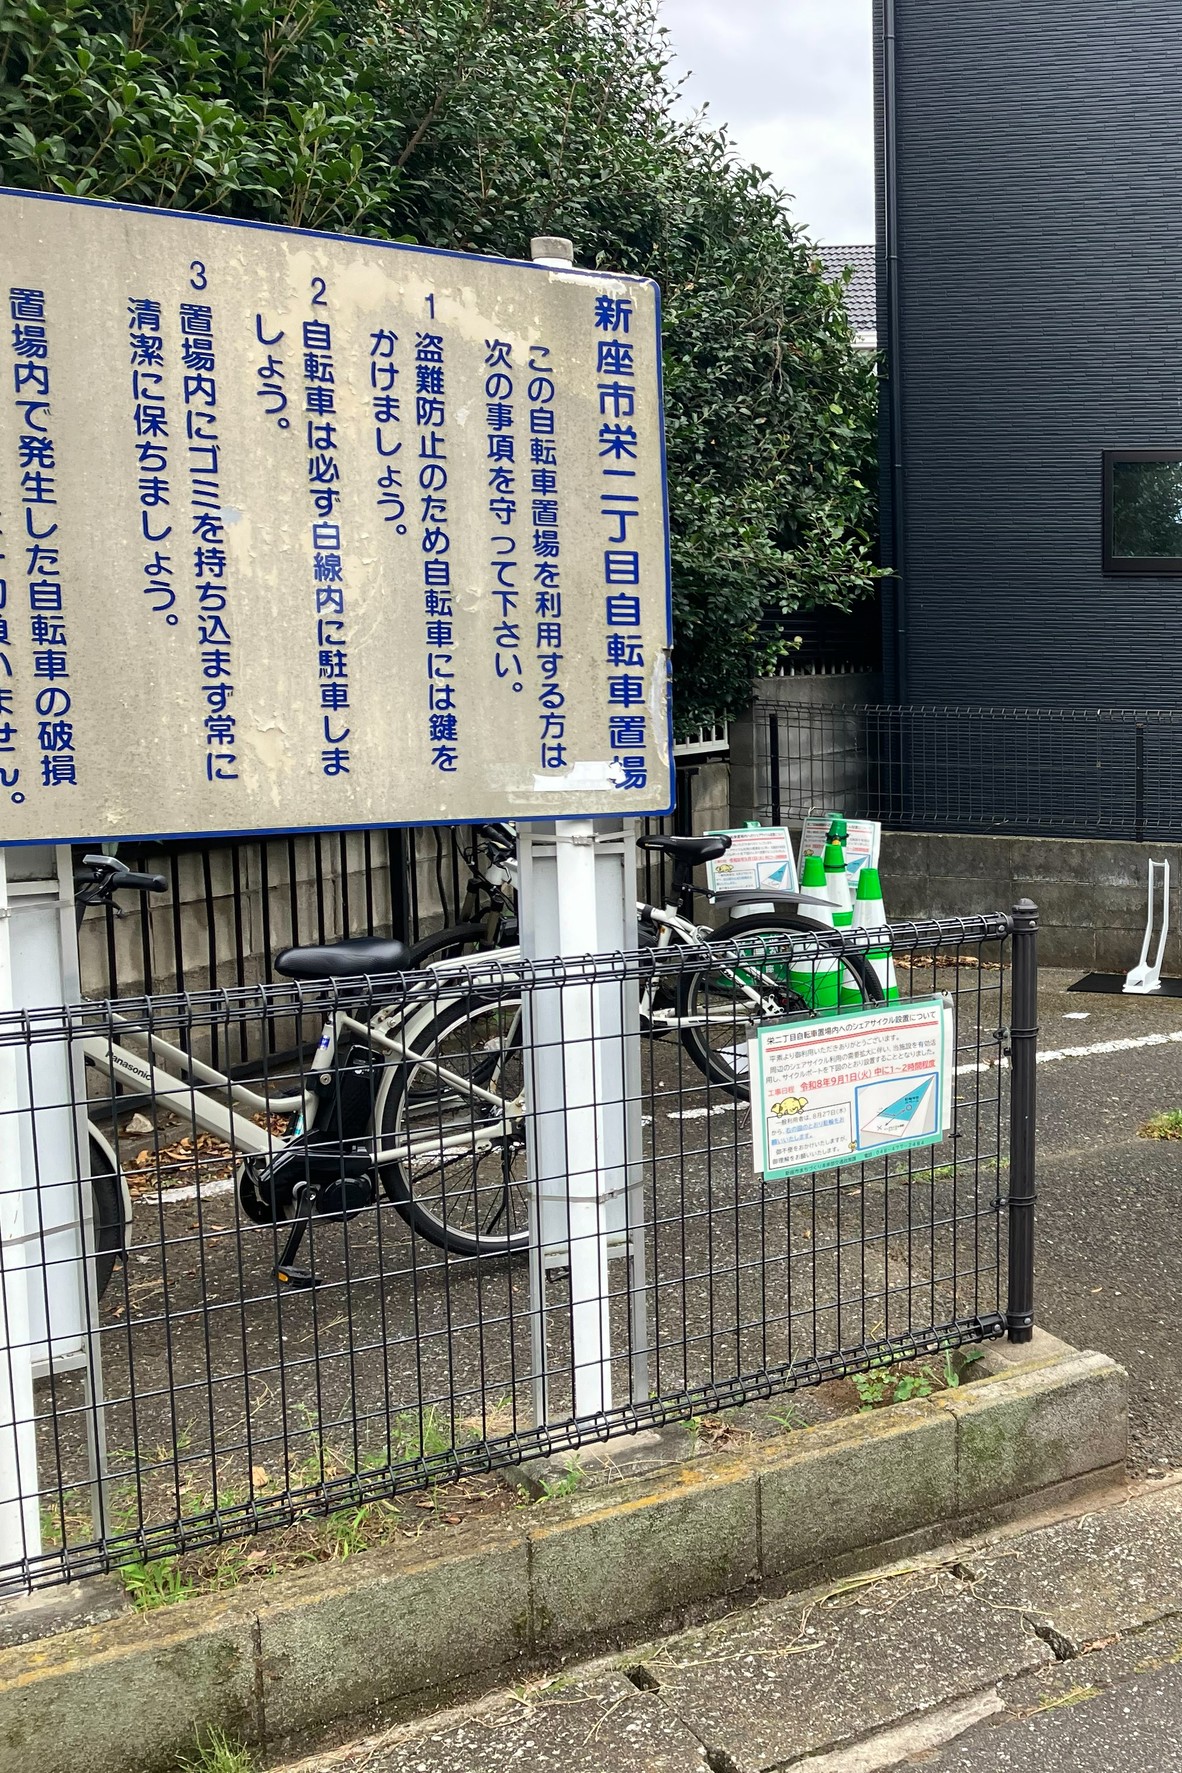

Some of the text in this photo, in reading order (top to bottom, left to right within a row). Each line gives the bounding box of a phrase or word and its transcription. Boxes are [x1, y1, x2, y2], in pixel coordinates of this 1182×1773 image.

[10, 288, 77, 786] 置場内で発生した自転車の破損
[127, 297, 178, 626] 清潔に保ちましょう。
[255, 314, 290, 429] しょう。
[370, 329, 407, 535] かけましょう。
[485, 339, 523, 692] 次の事項を守って下さい。
[594, 295, 648, 789] 新座市栄二丁目自転車置場
[527, 346, 568, 768] この自転車置場を利用する方は
